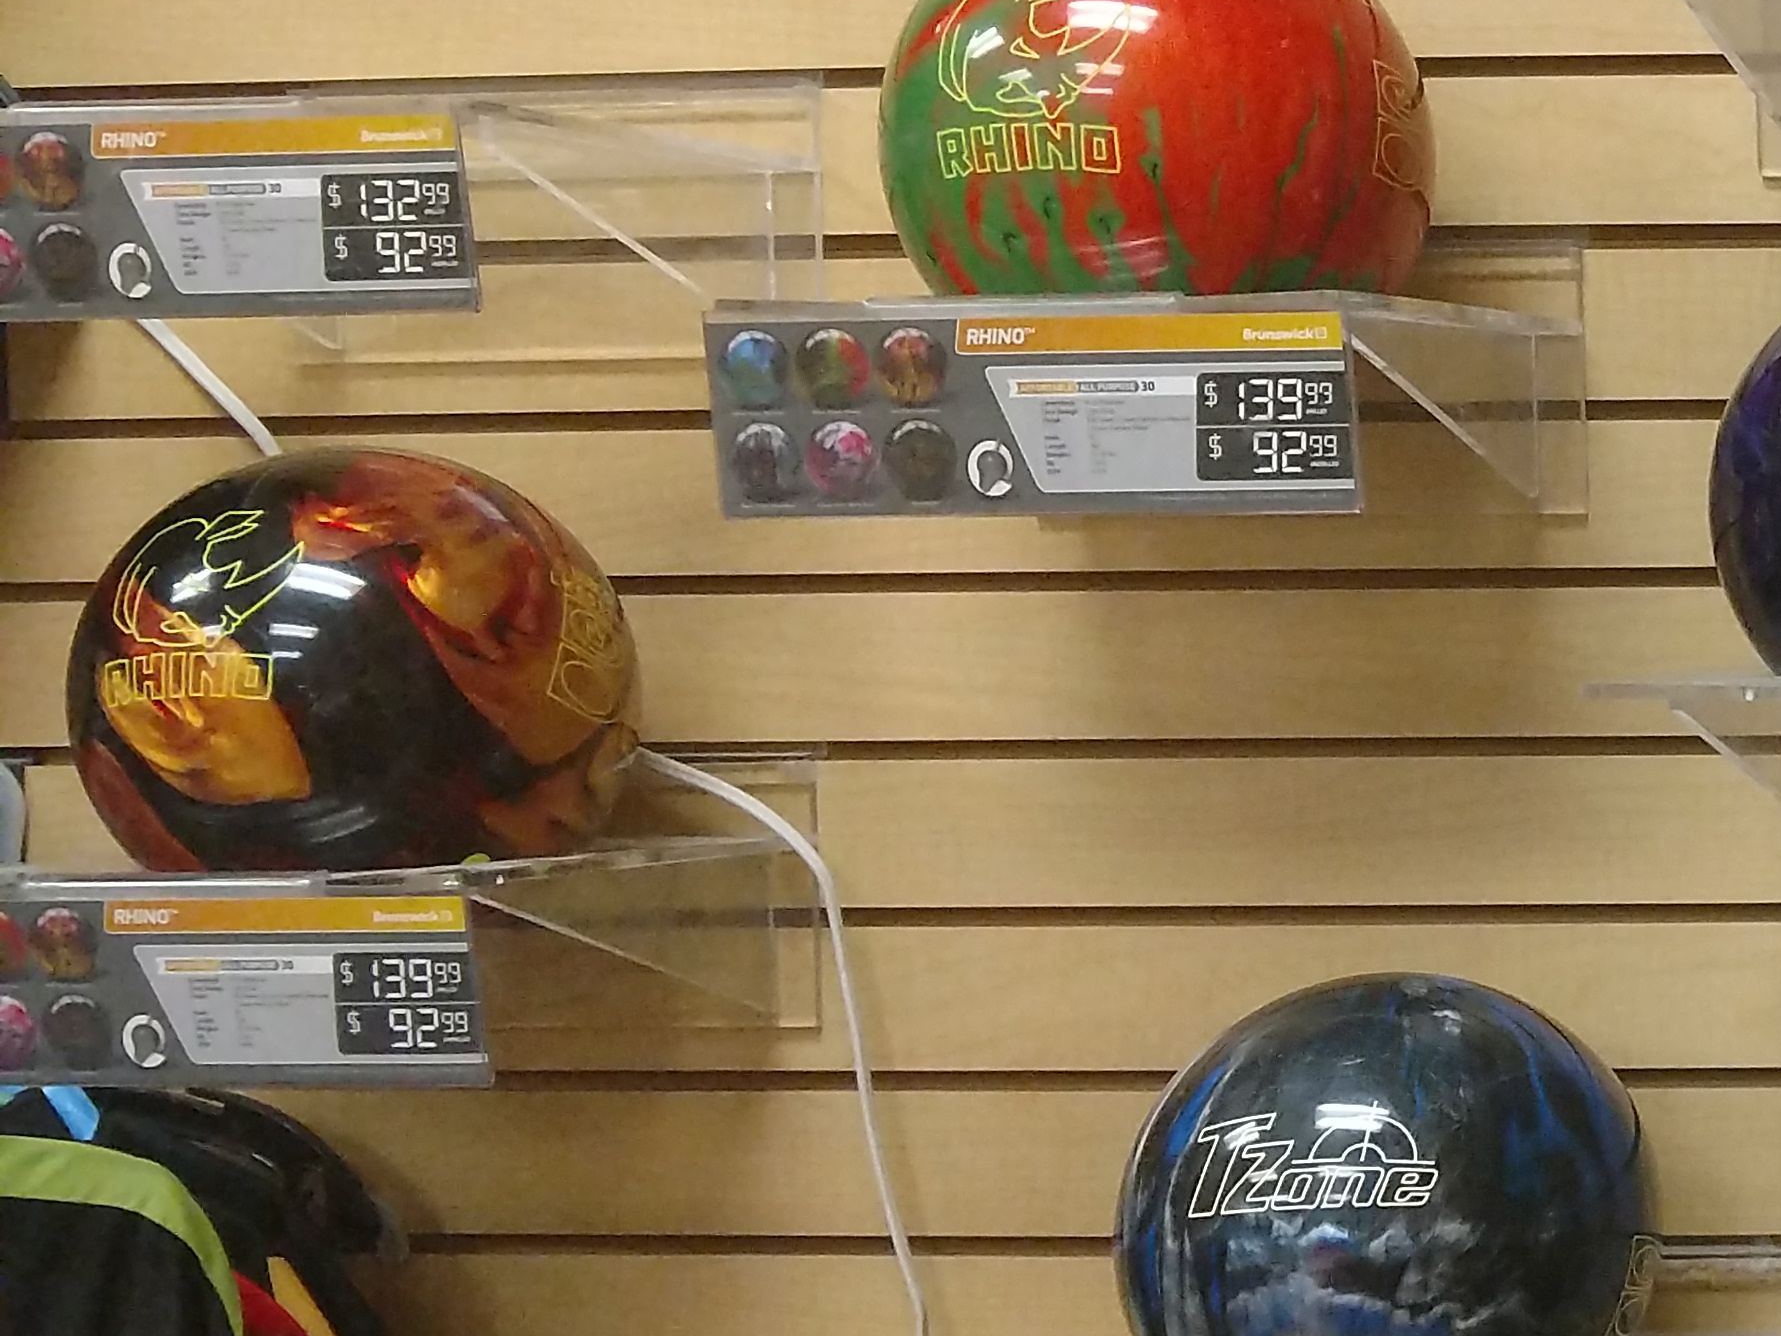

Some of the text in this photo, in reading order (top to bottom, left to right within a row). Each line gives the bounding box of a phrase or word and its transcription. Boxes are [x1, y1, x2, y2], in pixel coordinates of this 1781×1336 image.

[937, 122, 1121, 178] RHINO
[1141, 381, 1156, 392] 30
[1205, 381, 1217, 407] $
[1208, 433, 1222, 460] $
[105, 653, 273, 707] RHINO
